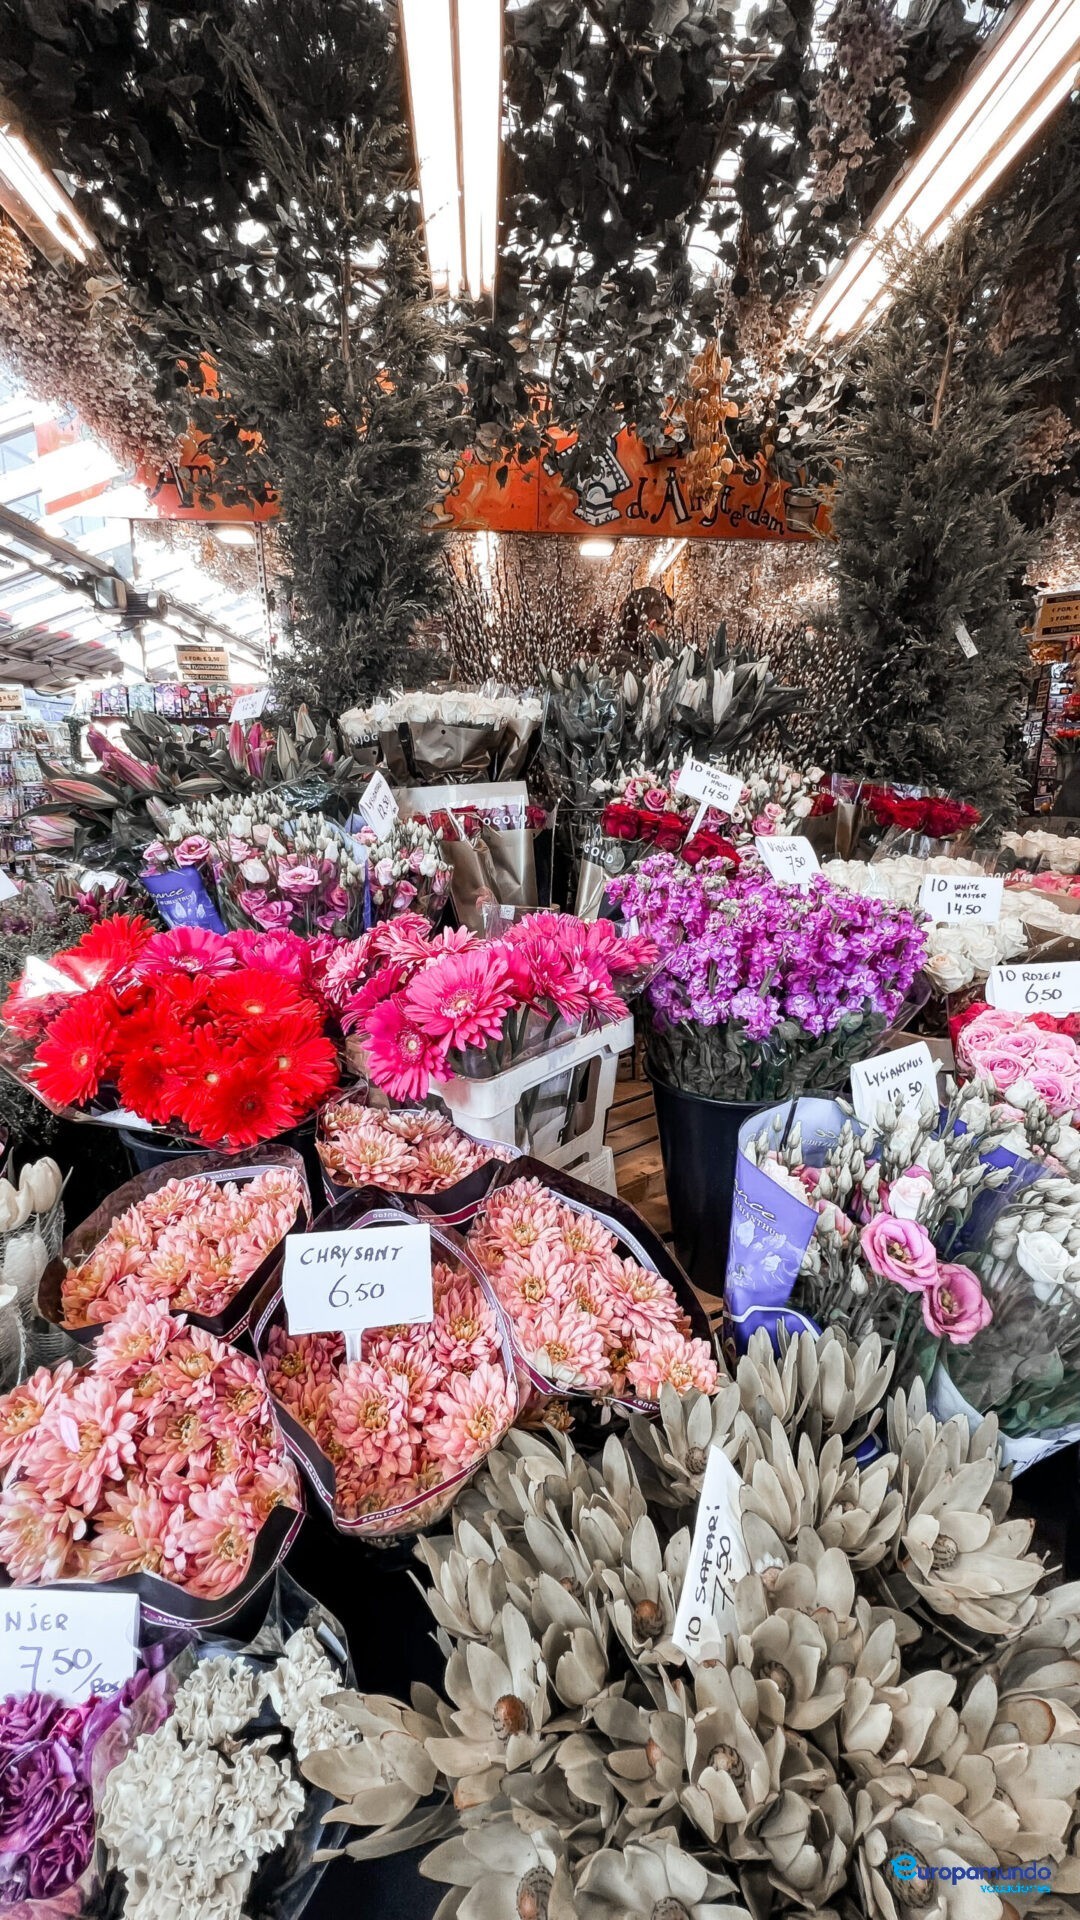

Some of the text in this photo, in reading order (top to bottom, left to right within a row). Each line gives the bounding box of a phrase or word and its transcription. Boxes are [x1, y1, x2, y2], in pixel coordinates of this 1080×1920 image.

[690, 762, 703, 773] 10
[931, 878, 948, 892] 10
[999, 969, 1061, 982] 10 ROZEN
[300, 1244, 404, 1268] CHRYSANT
[328, 1274, 385, 1308] 6.50
[685, 1616, 702, 1647] 10
